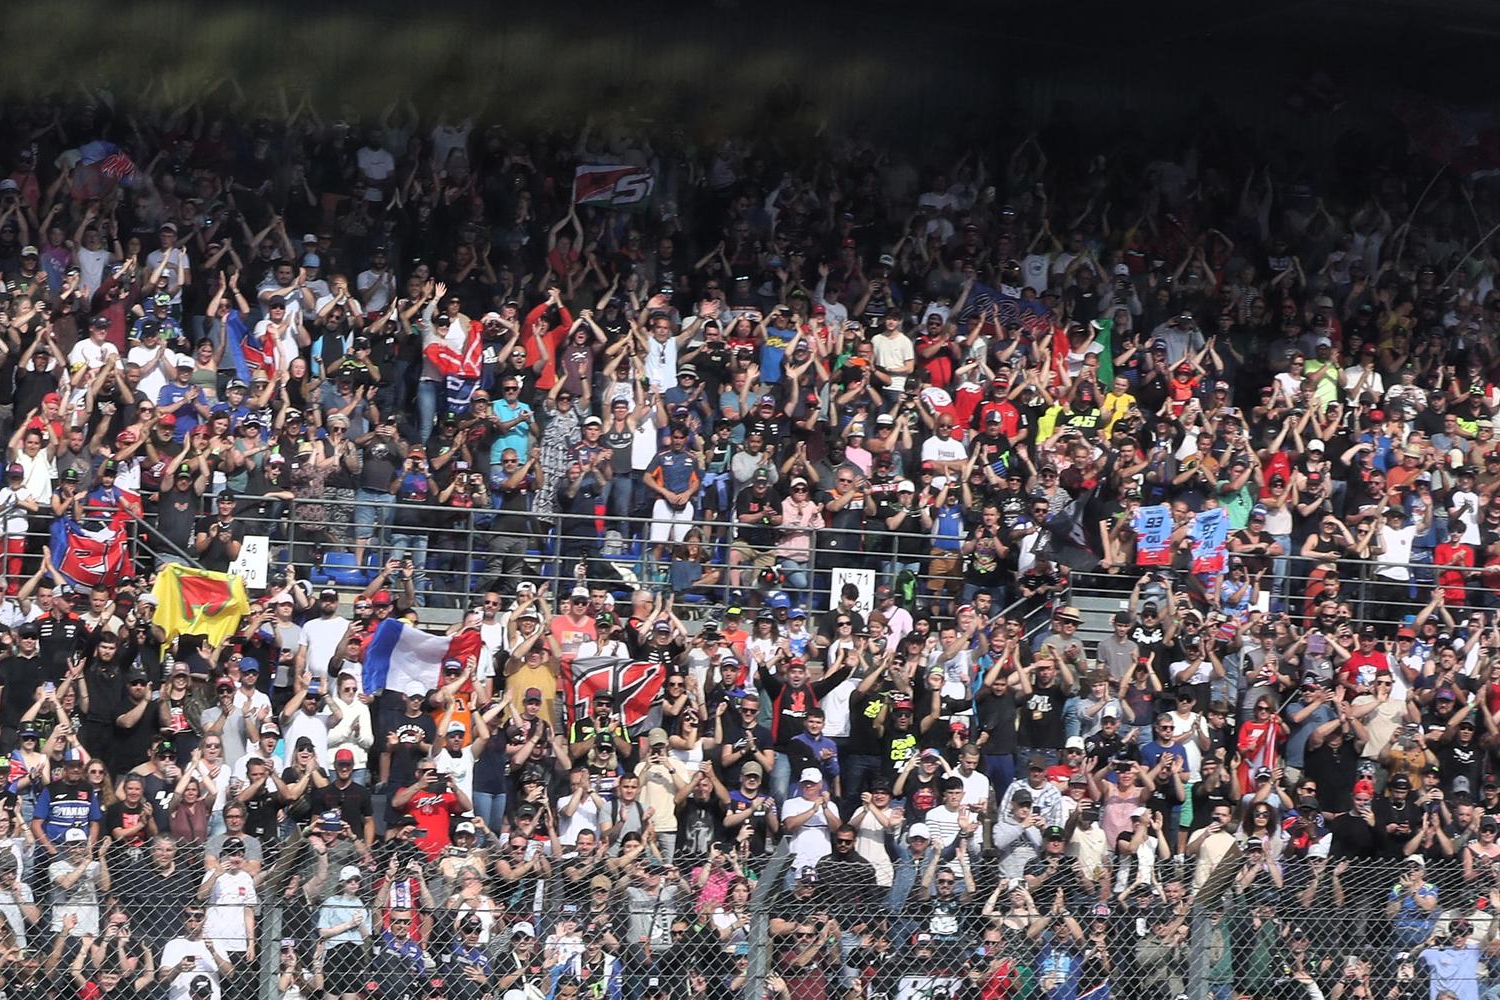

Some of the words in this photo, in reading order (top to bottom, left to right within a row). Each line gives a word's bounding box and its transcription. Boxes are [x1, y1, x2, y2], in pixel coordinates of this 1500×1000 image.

[1068, 416, 1095, 428] 46
[246, 543, 257, 555] 46
[244, 569, 256, 580] 70
[855, 573, 868, 585] 71
